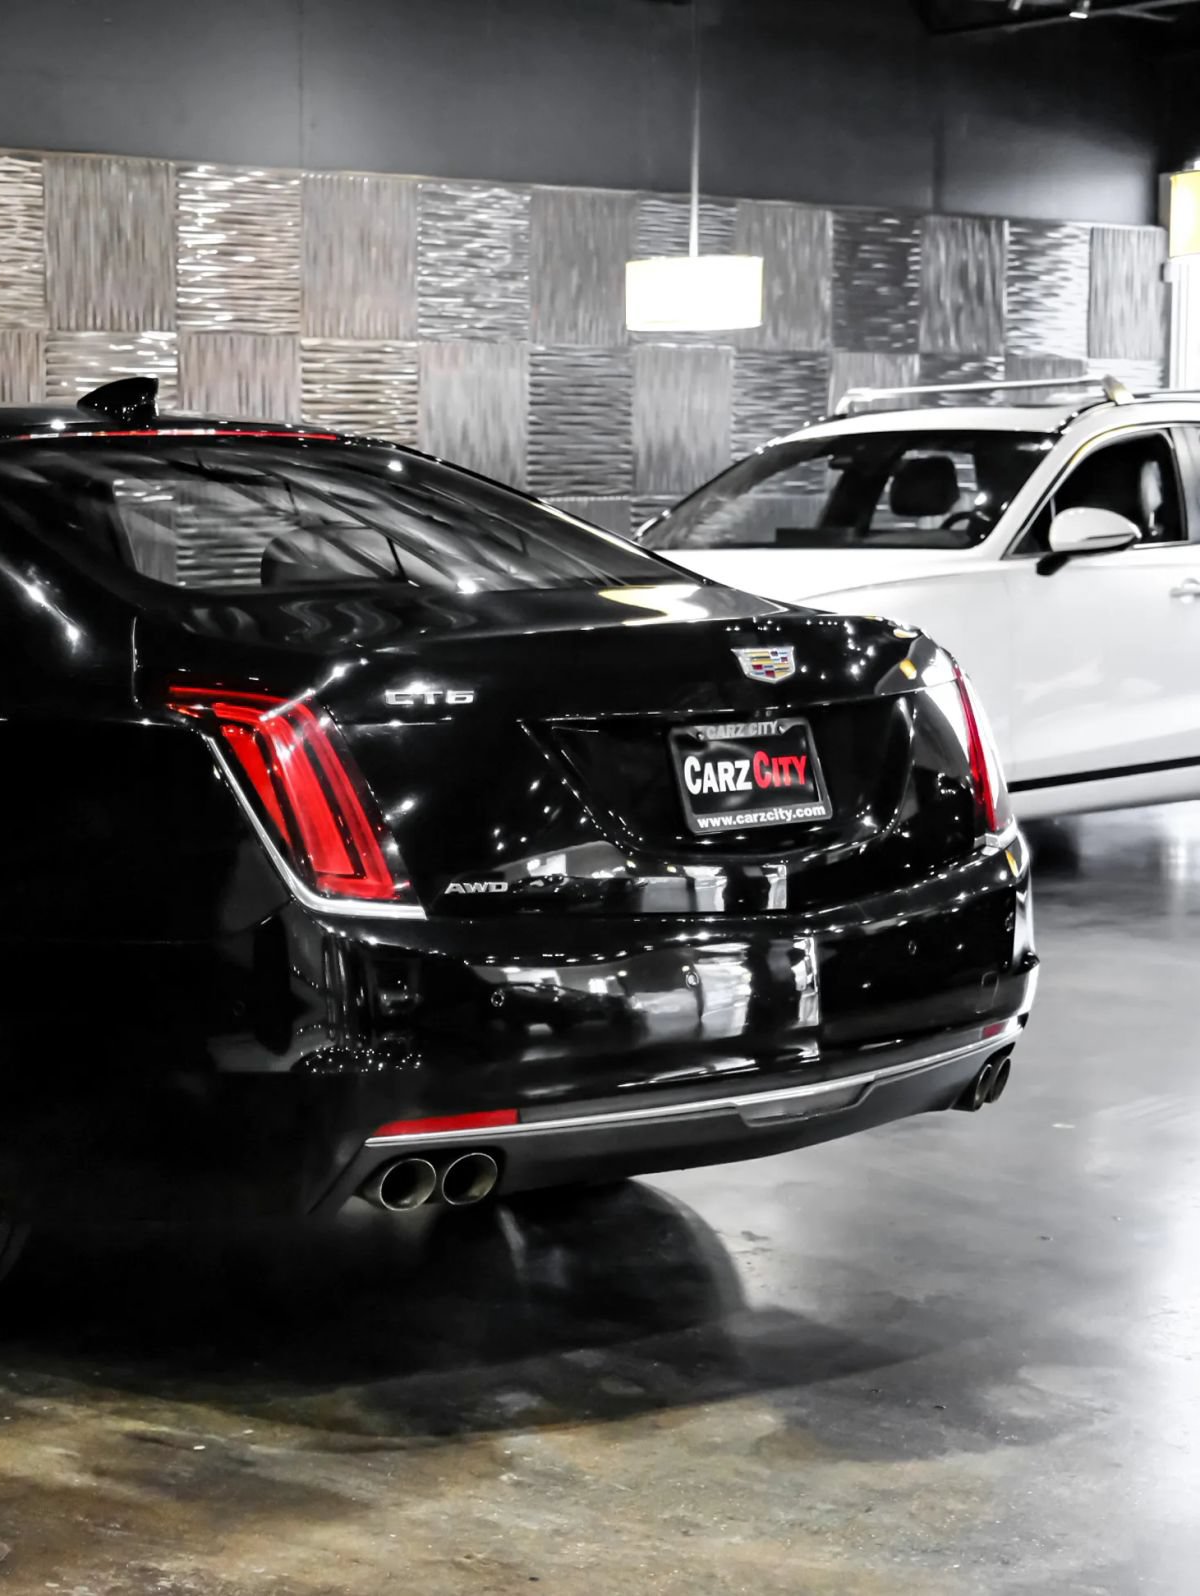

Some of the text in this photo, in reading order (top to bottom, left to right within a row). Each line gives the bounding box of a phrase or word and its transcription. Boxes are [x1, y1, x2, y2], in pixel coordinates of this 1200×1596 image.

[385, 689, 474, 705] CT6
[706, 721, 778, 740] CARZ CITY
[684, 751, 807, 795] CARZ CITY
[697, 805, 826, 828] www.carzcity.com
[444, 881, 508, 894] AWD
